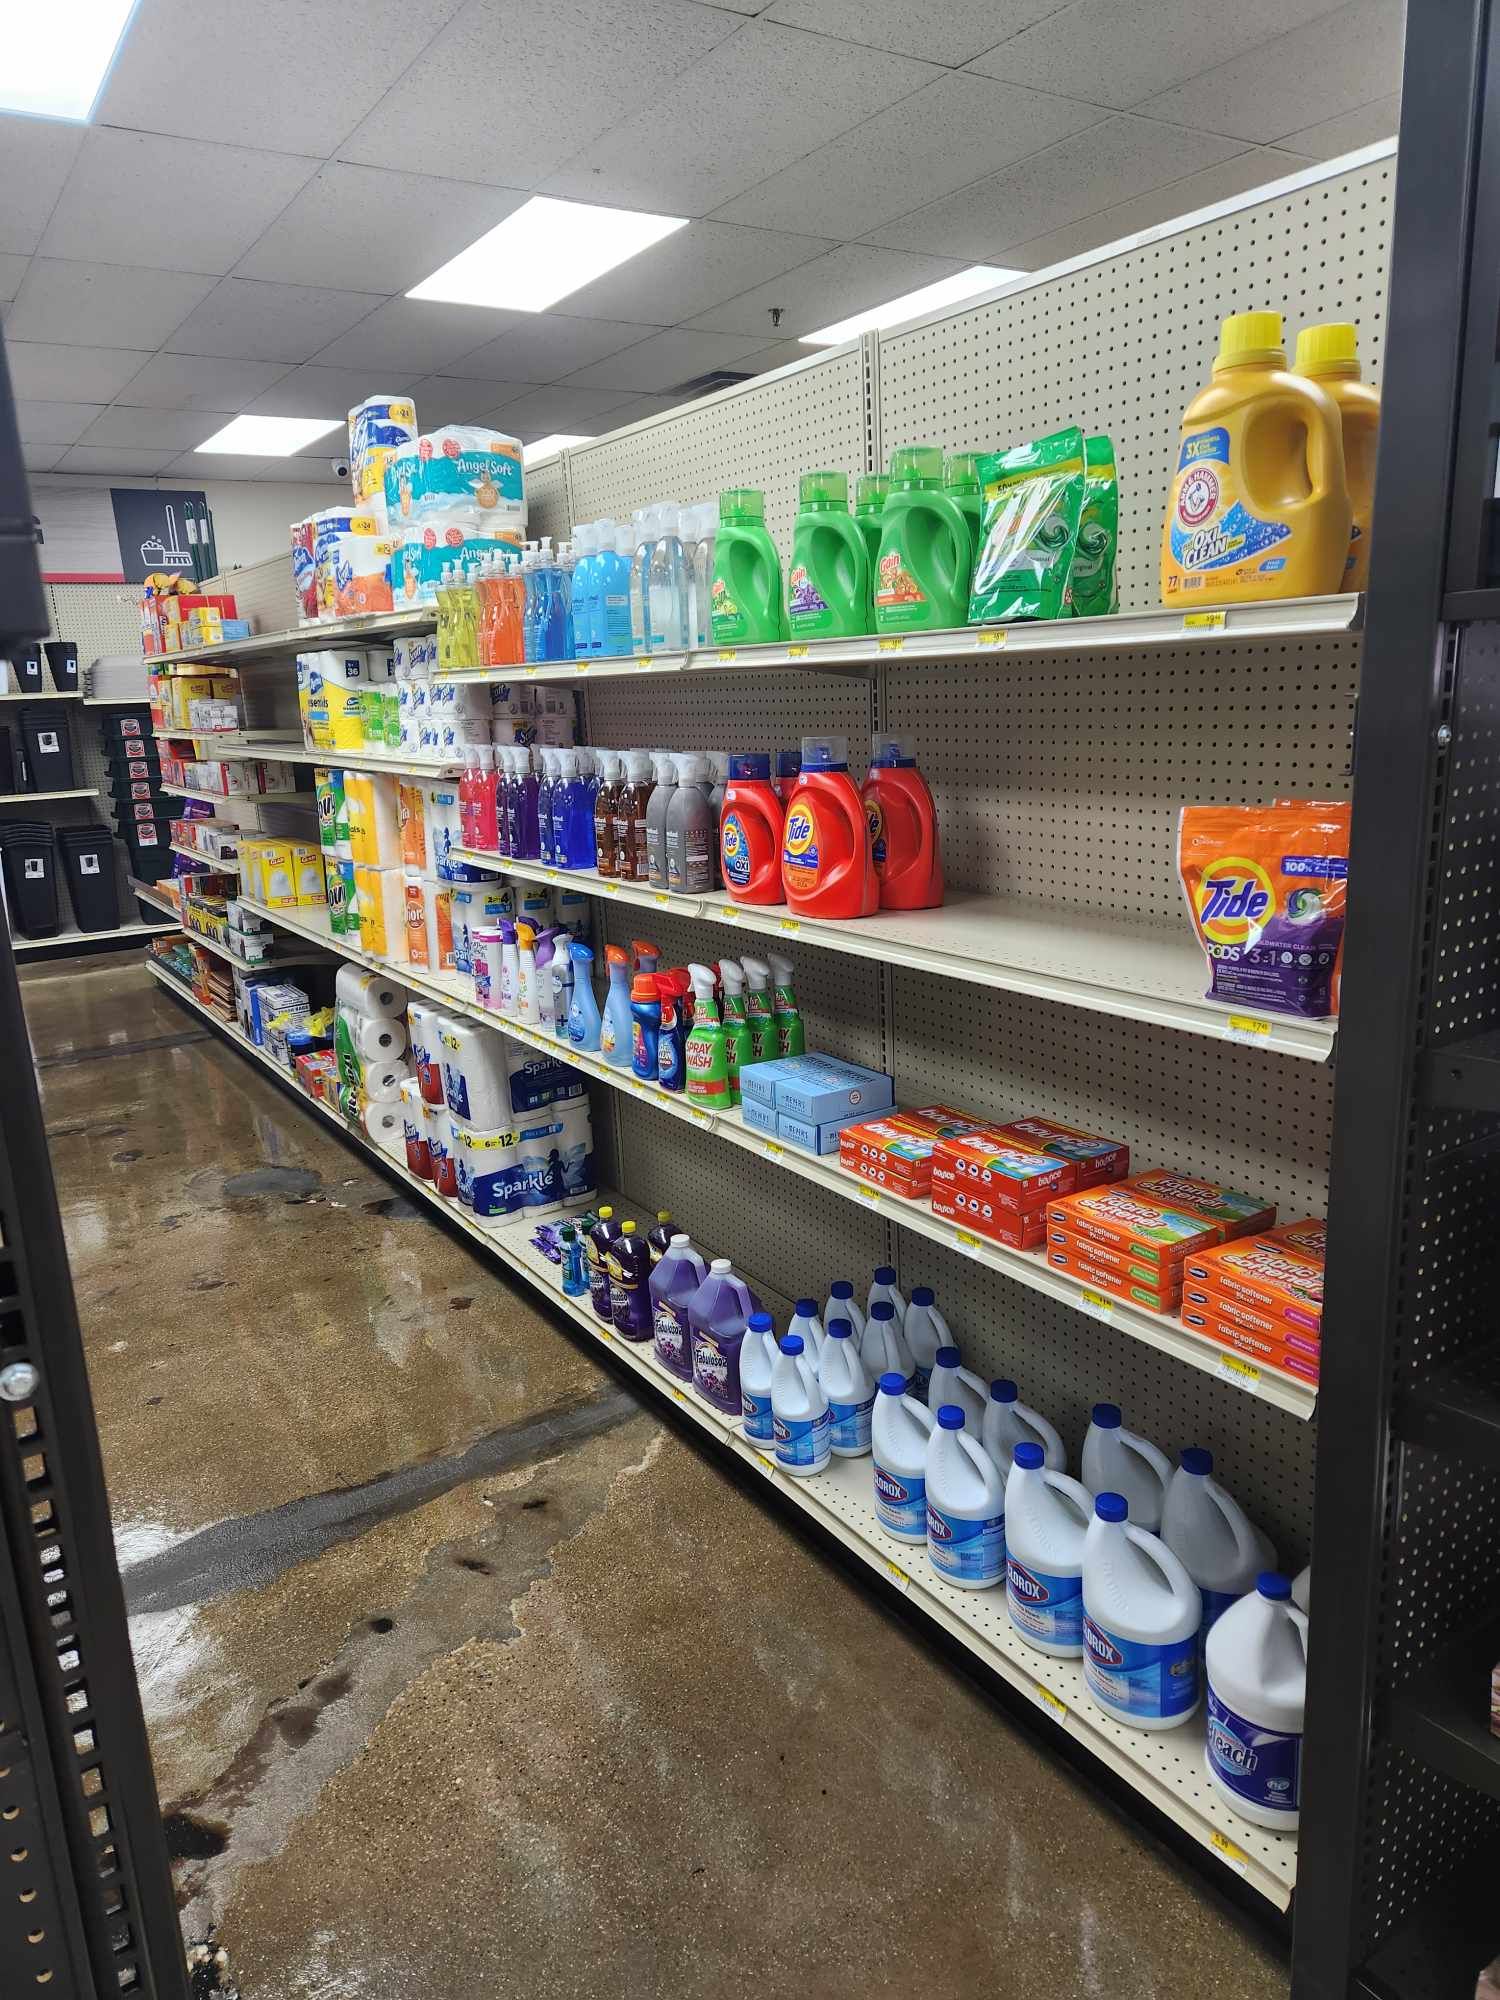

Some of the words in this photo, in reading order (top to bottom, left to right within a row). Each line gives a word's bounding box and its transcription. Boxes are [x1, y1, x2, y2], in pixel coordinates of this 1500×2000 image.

[457, 459, 490, 474] Angel
[491, 460, 513, 475] Soft
[1194, 526, 1219, 548] OXI
[1185, 536, 1228, 567] CLEAN
[880, 554, 901, 574] Gain
[348, 668, 358, 676] 36
[724, 831, 738, 847] Tide
[788, 815, 811, 842] Tide
[735, 860, 750, 872] OXI
[1284, 861, 1313, 874] 100%
[1201, 879, 1270, 925] Tide
[1207, 943, 1240, 962] PODS
[1257, 940, 1292, 949] OLDWATER
[687, 1041, 713, 1054] SPRAY
[524, 1057, 563, 1076] Spark
[687, 1056, 713, 1069] WASH
[499, 1133, 513, 1148] 12
[1014, 1121, 1101, 1149] bounce
[958, 1135, 1045, 1166] bounce
[1095, 1152, 1117, 1168] bounce
[933, 1166, 956, 1181] bounce
[1038, 1170, 1062, 1187] bounce
[492, 1171, 555, 1200] Sparkle
[1138, 1180, 1227, 1209] softener
[1159, 1178, 1217, 1200] fabric
[933, 1200, 956, 1215] bounce
[1079, 1199, 1167, 1228] softener
[1099, 1196, 1160, 1219] fabric
[1076, 1218, 1093, 1232] fabric
[1093, 1225, 1121, 1242] softener
[1076, 1240, 1093, 1255] fabric
[1093, 1247, 1121, 1264] softener
[1078, 1261, 1095, 1275] fabric
[1095, 1268, 1122, 1286] softener
[1223, 1255, 1323, 1292] softener
[1245, 1251, 1316, 1278] fabric
[1219, 1275, 1240, 1290] fabric
[1241, 1286, 1273, 1305] softener
[1219, 1301, 1240, 1317] fabric
[1241, 1312, 1274, 1331] softener
[1217, 1323, 1239, 1339] fabric
[1239, 1334, 1273, 1354] softener
[696, 1349, 722, 1367] Fabuloso
